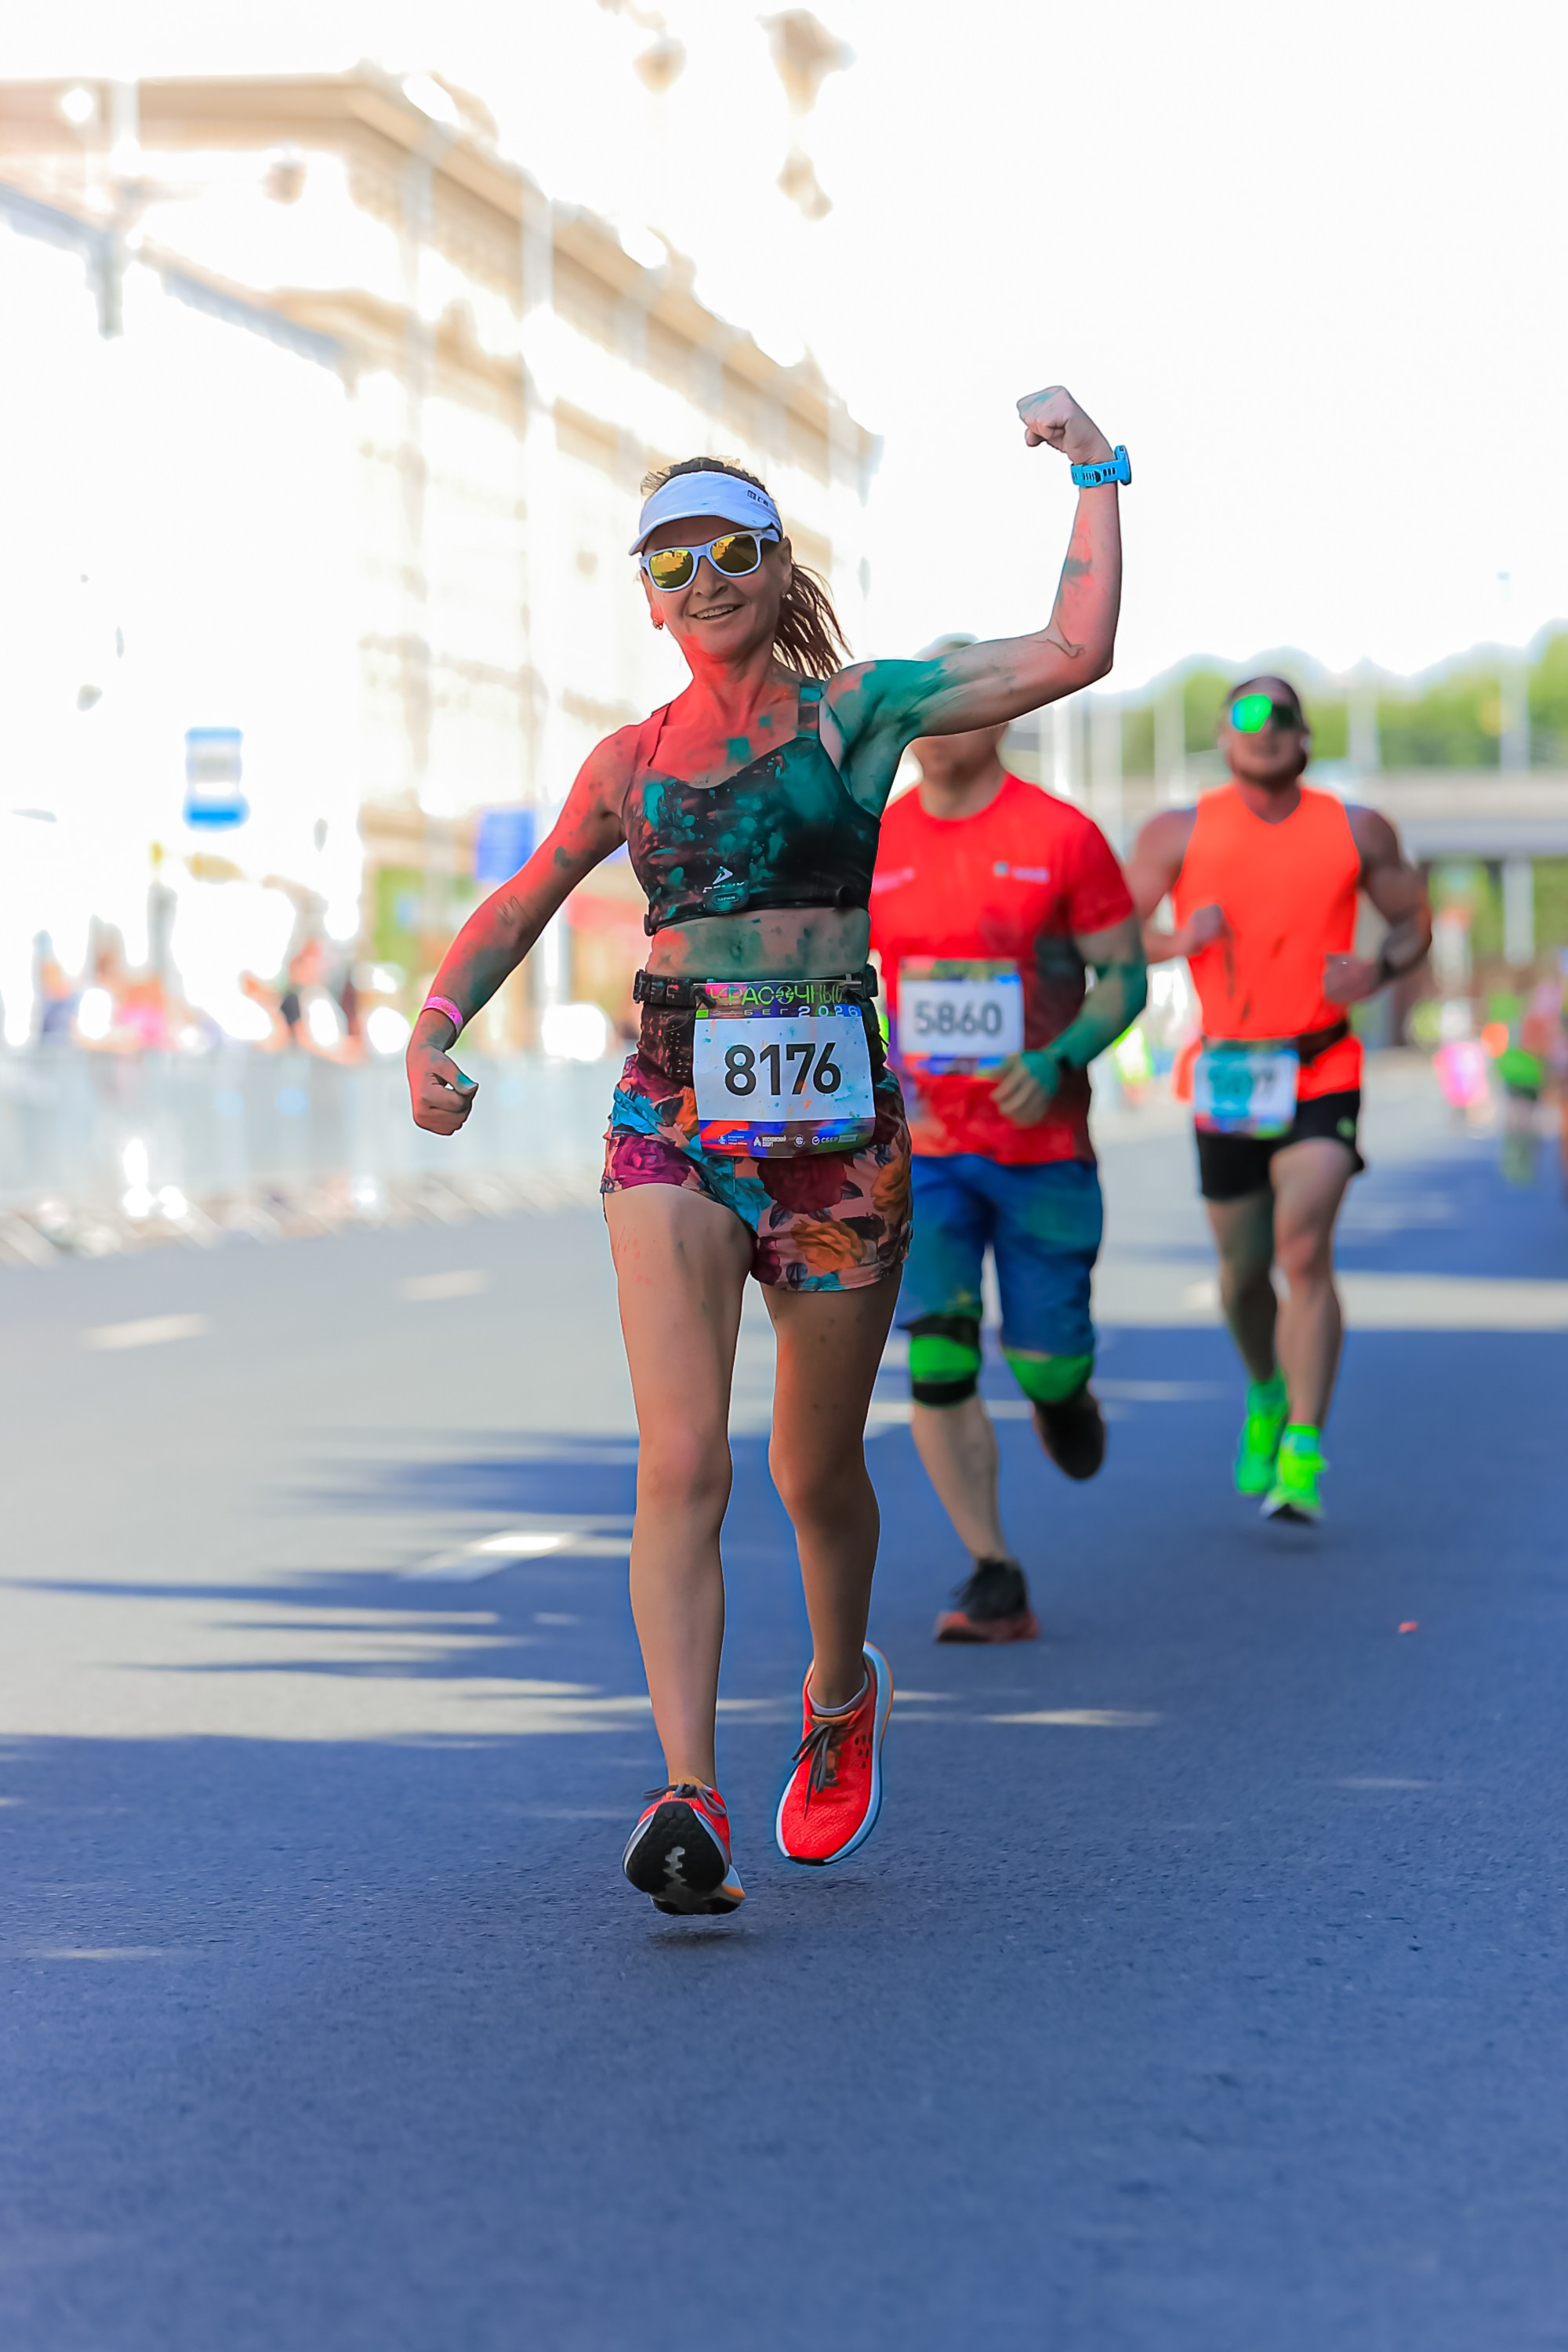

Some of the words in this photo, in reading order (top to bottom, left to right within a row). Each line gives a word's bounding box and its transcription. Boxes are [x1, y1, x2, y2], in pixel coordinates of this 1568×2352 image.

[798, 1006, 858, 1018] 2026
[914, 1000, 1002, 1037] 5860
[725, 1043, 841, 1096] 8176
